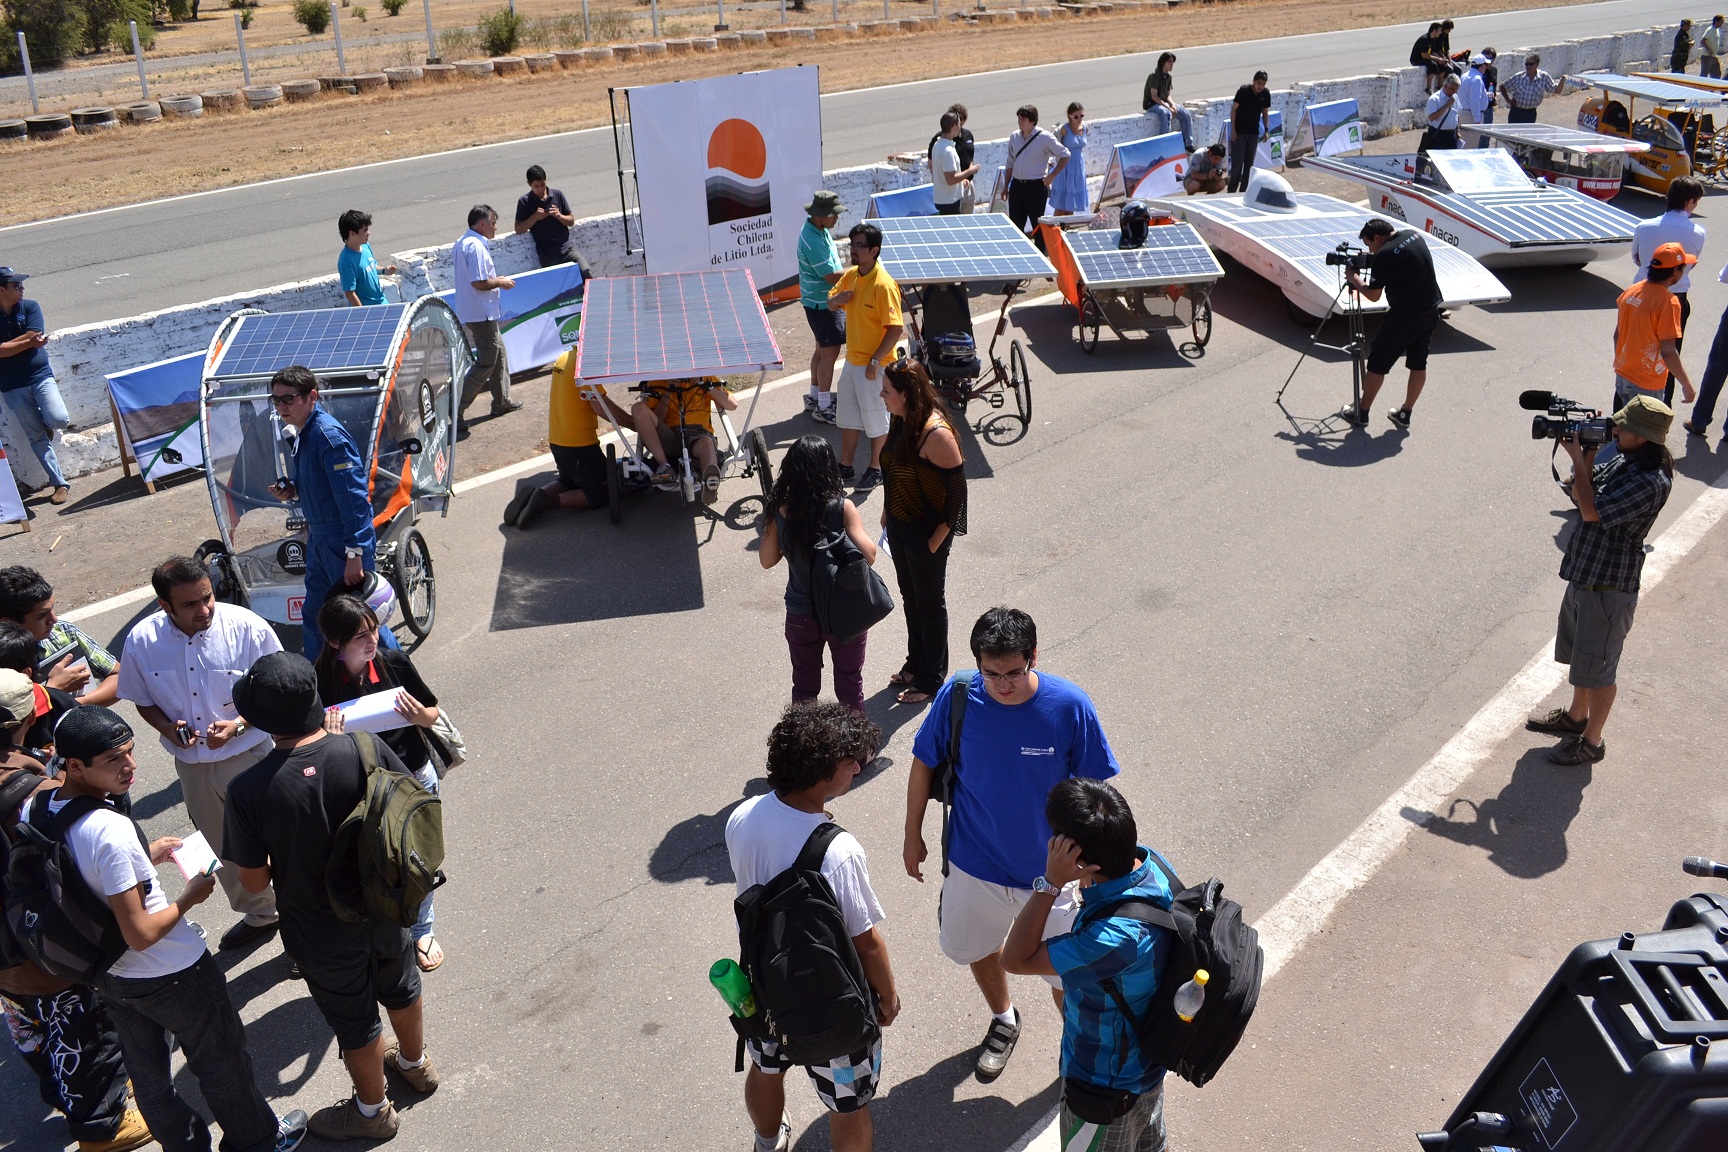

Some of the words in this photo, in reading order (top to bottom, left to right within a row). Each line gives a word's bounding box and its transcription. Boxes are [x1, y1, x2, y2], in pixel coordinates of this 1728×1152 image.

[1684, 99, 1698, 108] JA
[730, 216, 773, 234] Sociedad
[737, 231, 774, 246] Chilena
[711, 254, 722, 265] de
[724, 248, 747, 262] Litio
[750, 243, 774, 257] Ltda.
